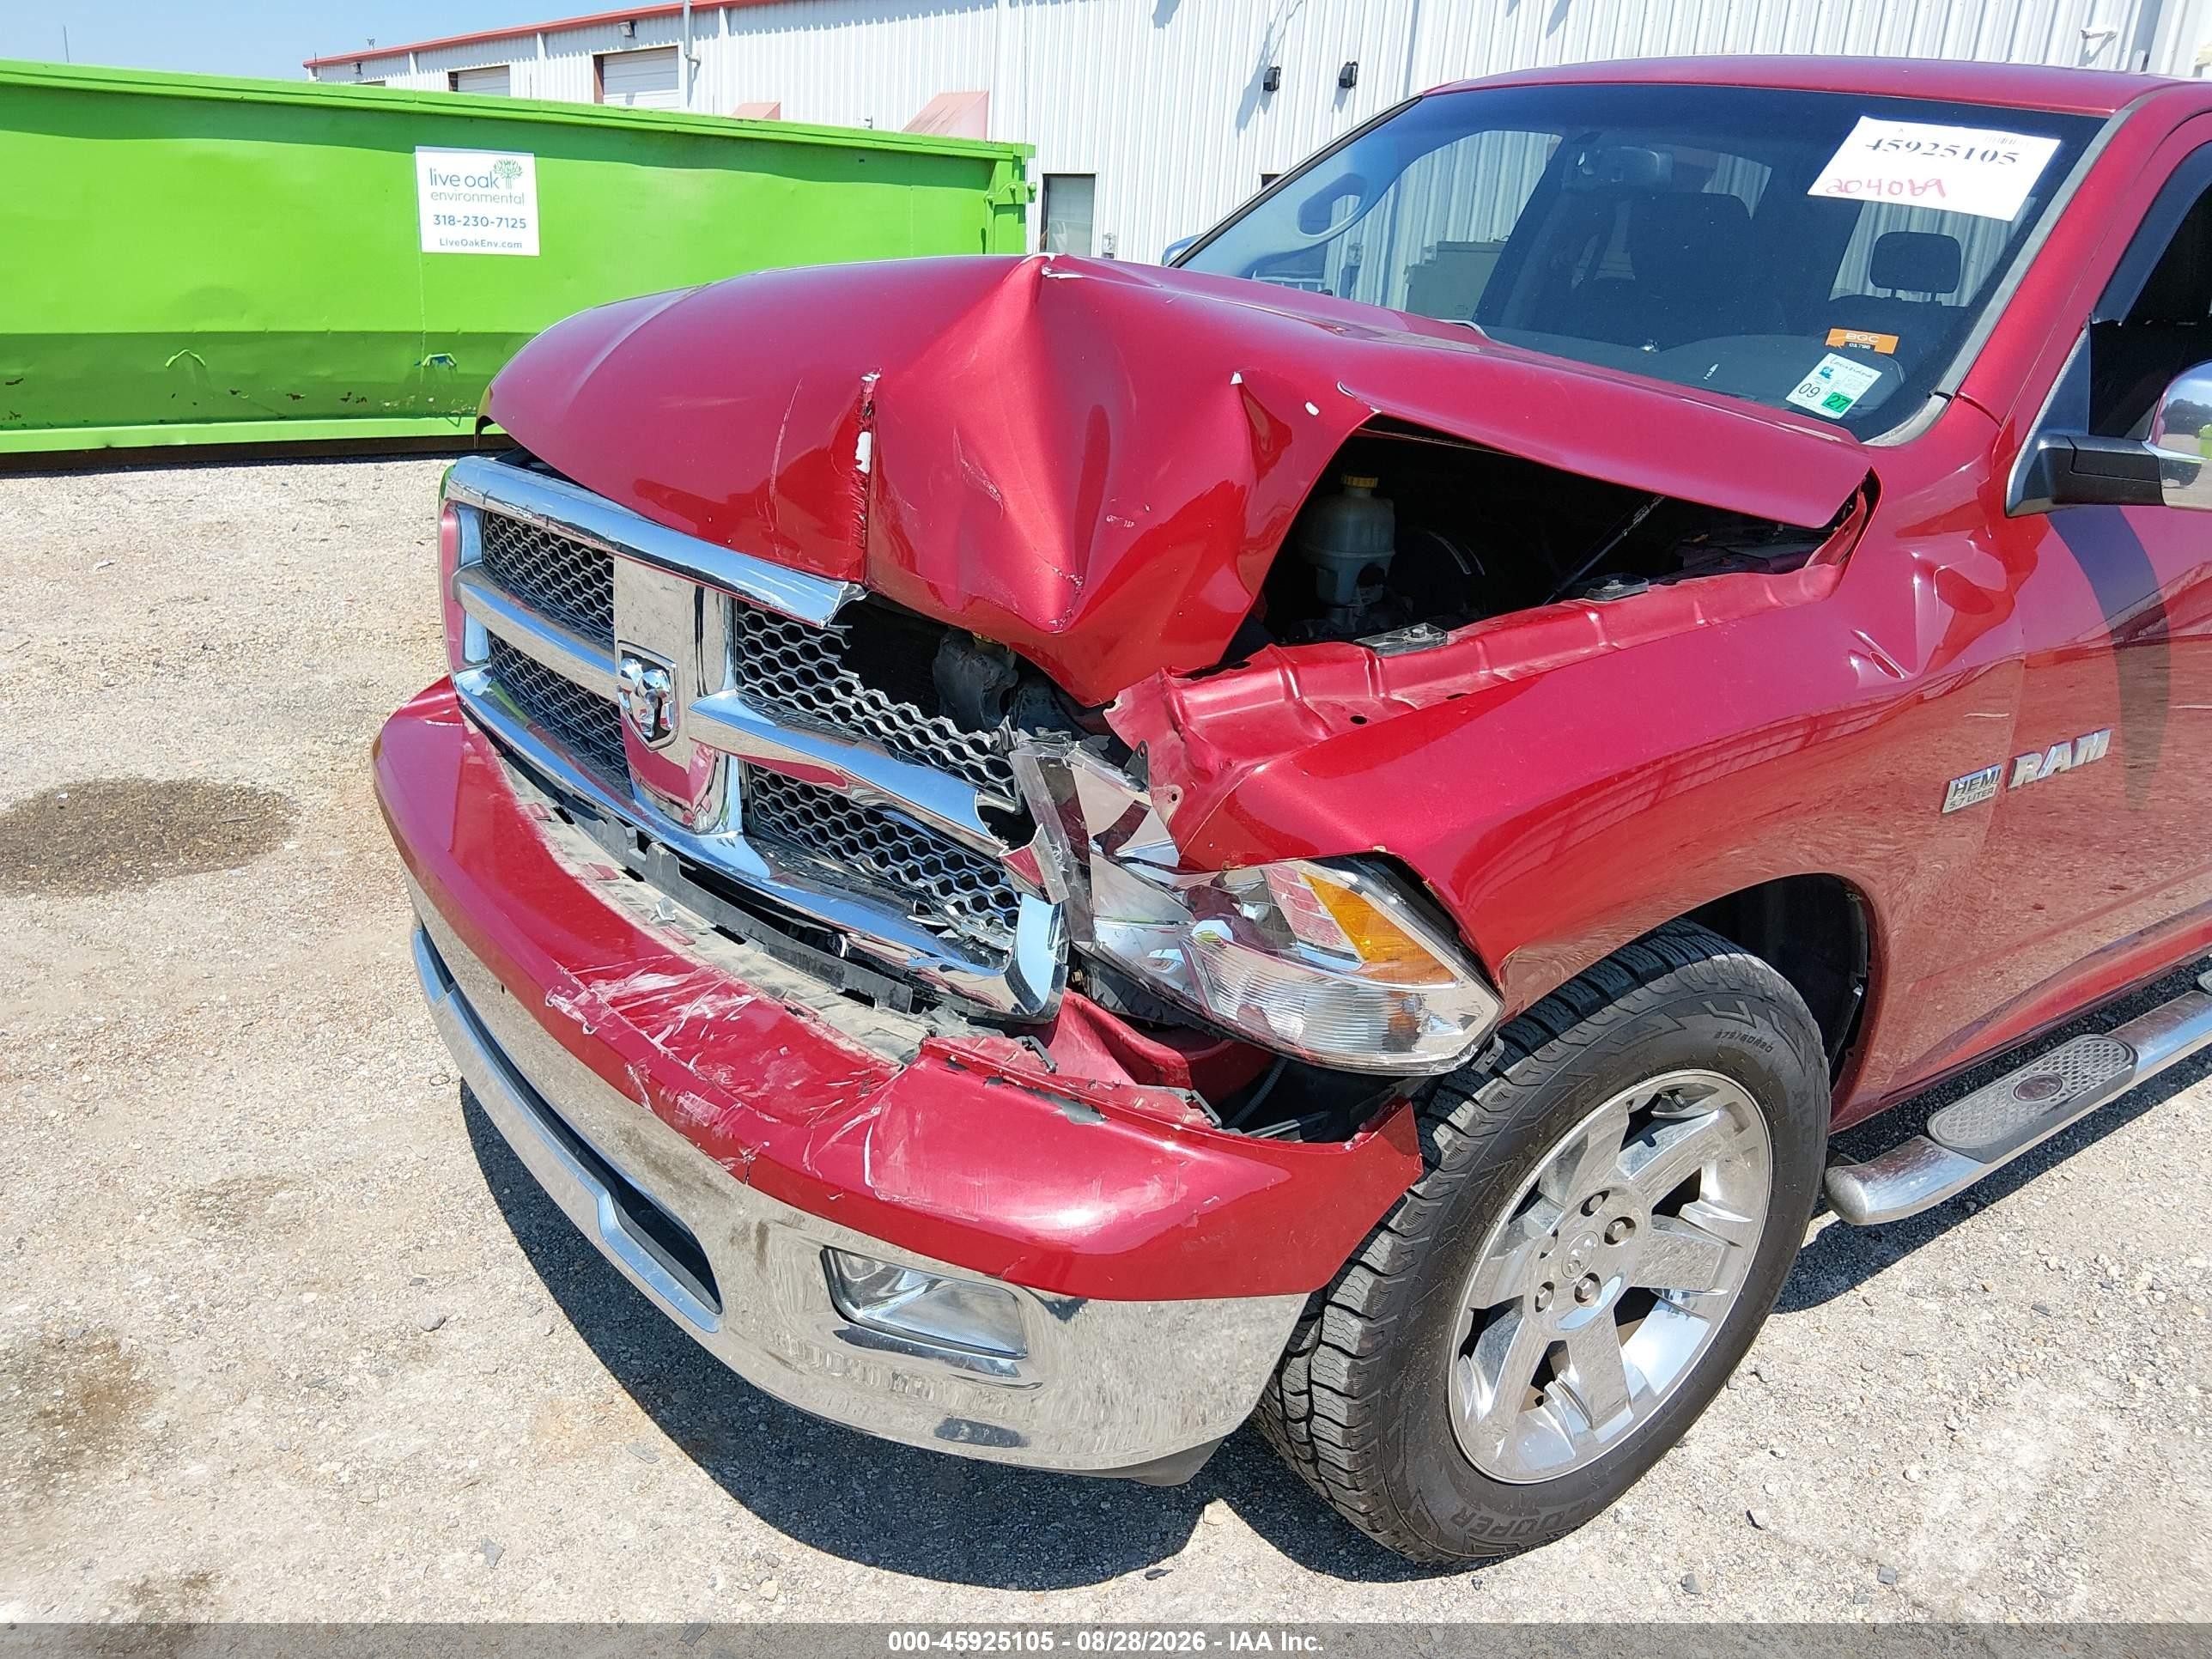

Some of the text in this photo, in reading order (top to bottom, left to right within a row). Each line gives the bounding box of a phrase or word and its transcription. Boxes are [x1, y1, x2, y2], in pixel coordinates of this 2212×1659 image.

[1865, 137, 2021, 165] 45925105
[429, 167, 500, 189] live oak
[430, 190, 525, 206] environmental
[433, 215, 527, 229] 318-230-7125
[439, 238, 523, 249] LiveOakEnv.com
[1845, 332, 1881, 343] BGC
[1798, 383, 1820, 398] 09
[1826, 395, 1850, 410] 27
[2008, 728, 2112, 792] RAM
[1953, 768, 2002, 798] HEMI
[1948, 787, 1995, 810] 5.7 LITER
